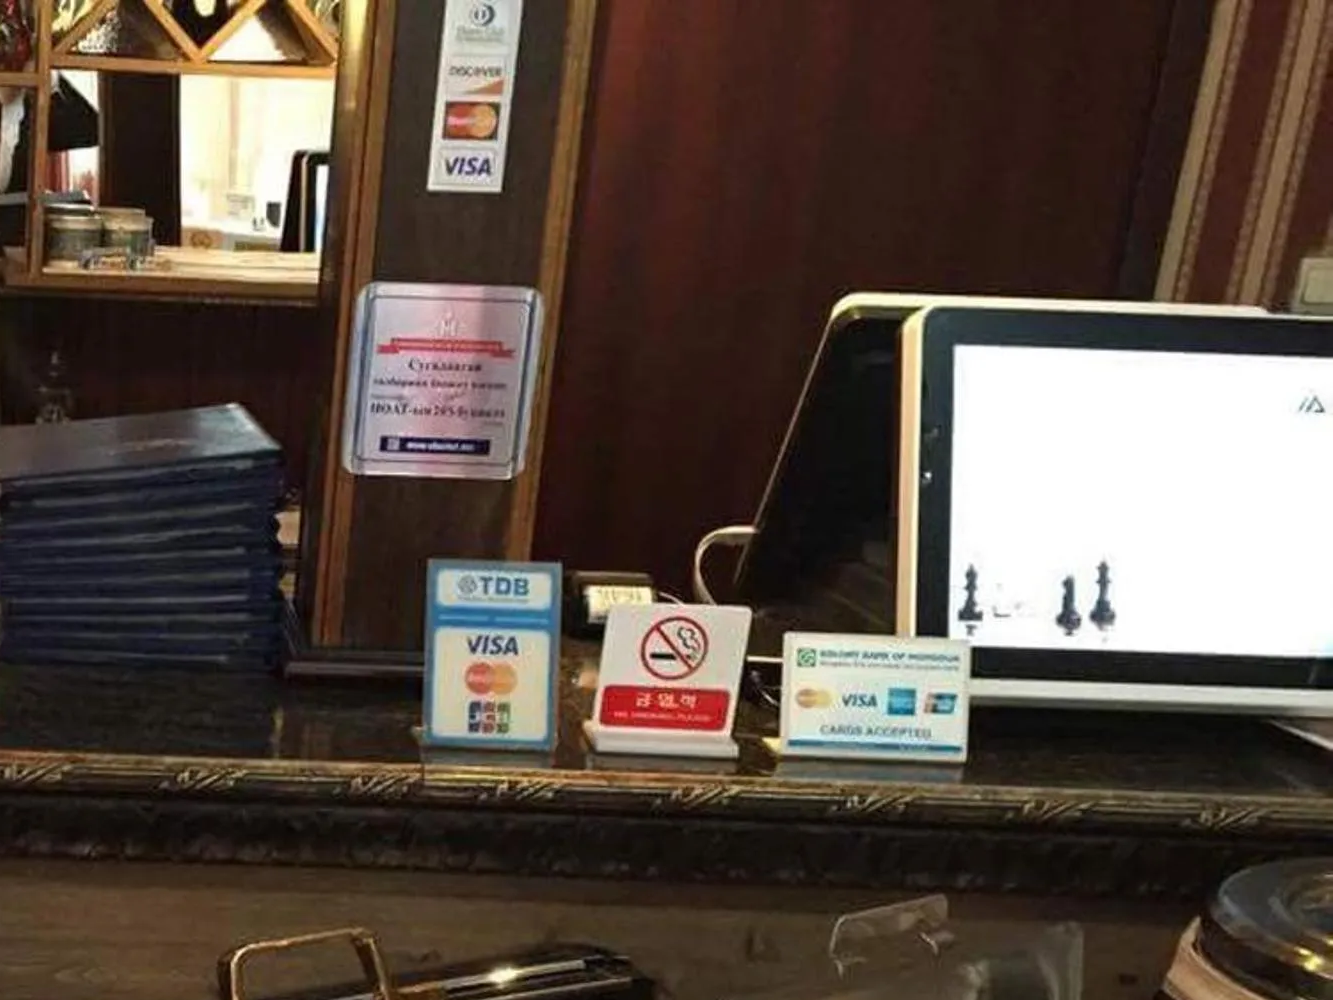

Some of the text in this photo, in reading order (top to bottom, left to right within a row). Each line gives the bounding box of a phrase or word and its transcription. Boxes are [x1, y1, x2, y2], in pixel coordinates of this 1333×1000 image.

[448, 66, 502, 77] DISCOVER
[445, 157, 492, 176] VISA
[480, 577, 530, 596] TDB
[466, 635, 520, 655] VISA
[842, 694, 878, 708] VISA
[820, 724, 932, 739] CARDS ACCEPTED
